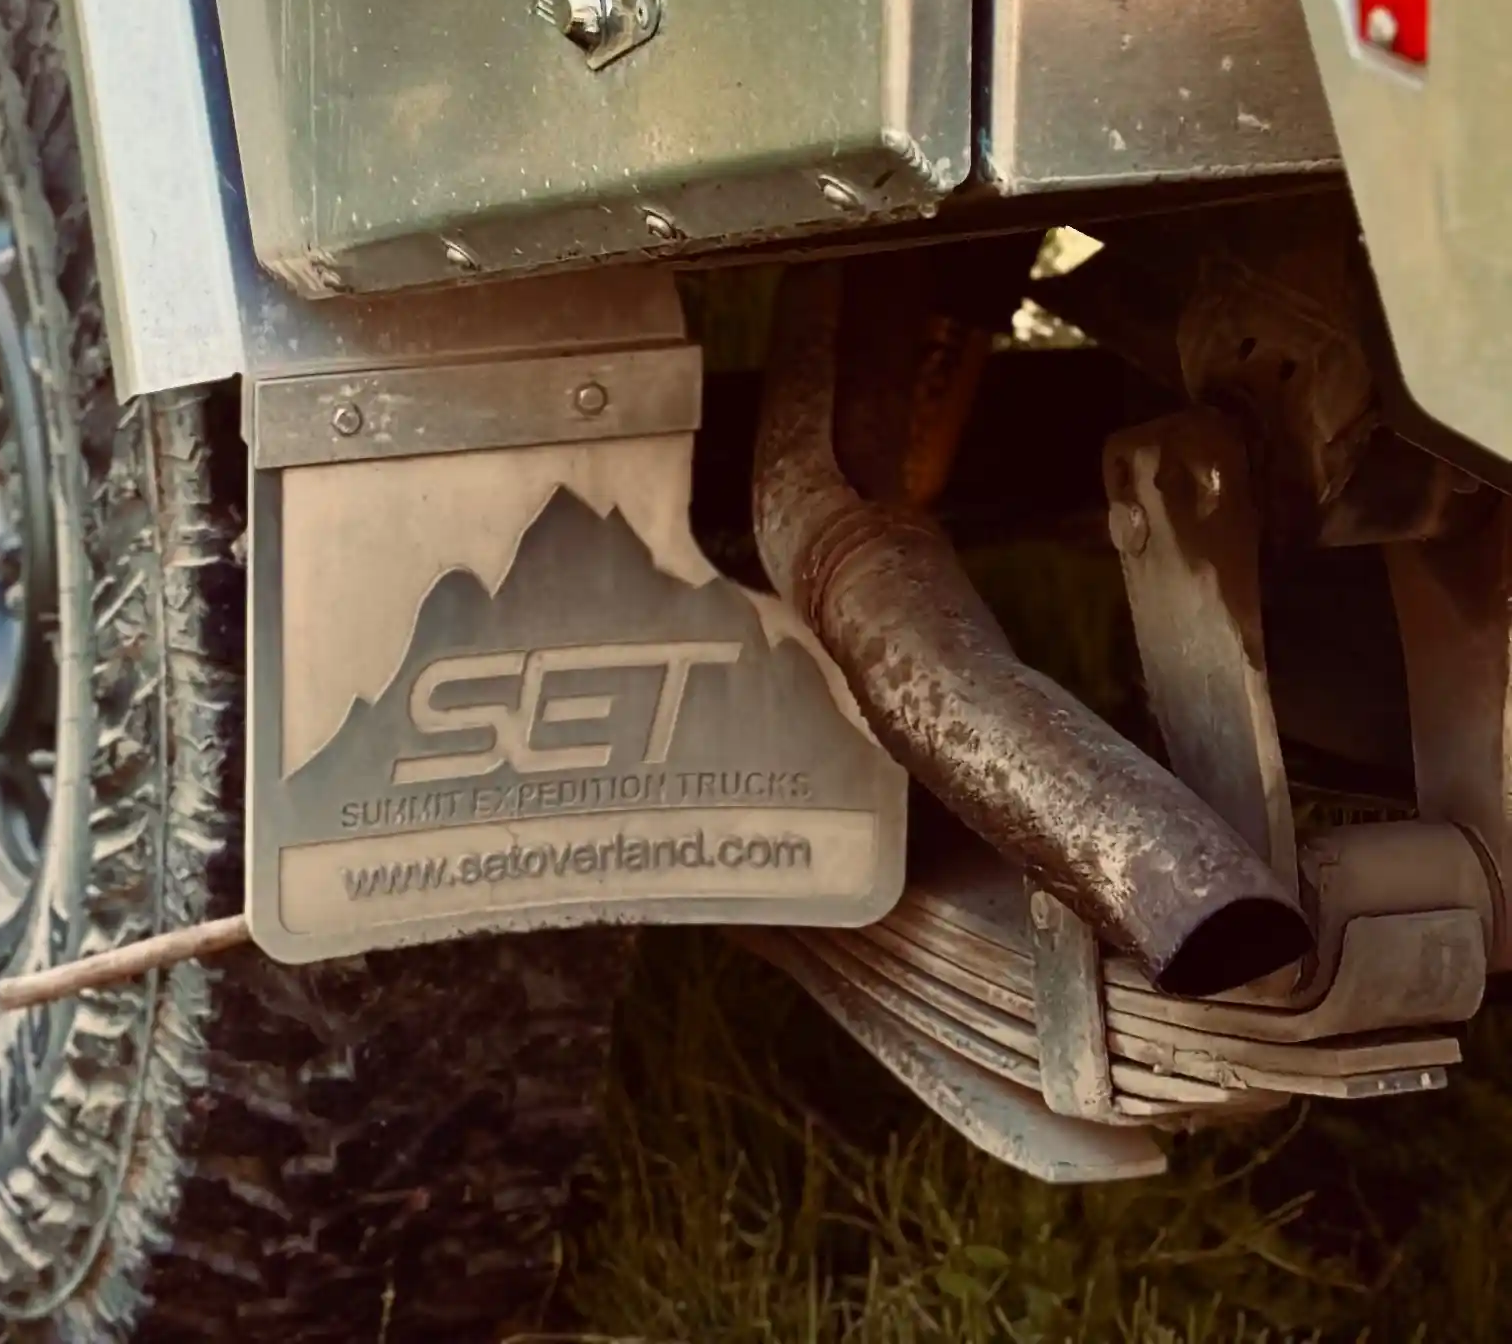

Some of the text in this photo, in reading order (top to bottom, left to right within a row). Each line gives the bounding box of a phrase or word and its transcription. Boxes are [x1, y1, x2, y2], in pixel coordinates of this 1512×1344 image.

[390, 641, 744, 786] SET
[340, 771, 810, 830] SUMMIT EXPEDITION TRUCKS
[340, 827, 813, 901] www.setoverland.com
